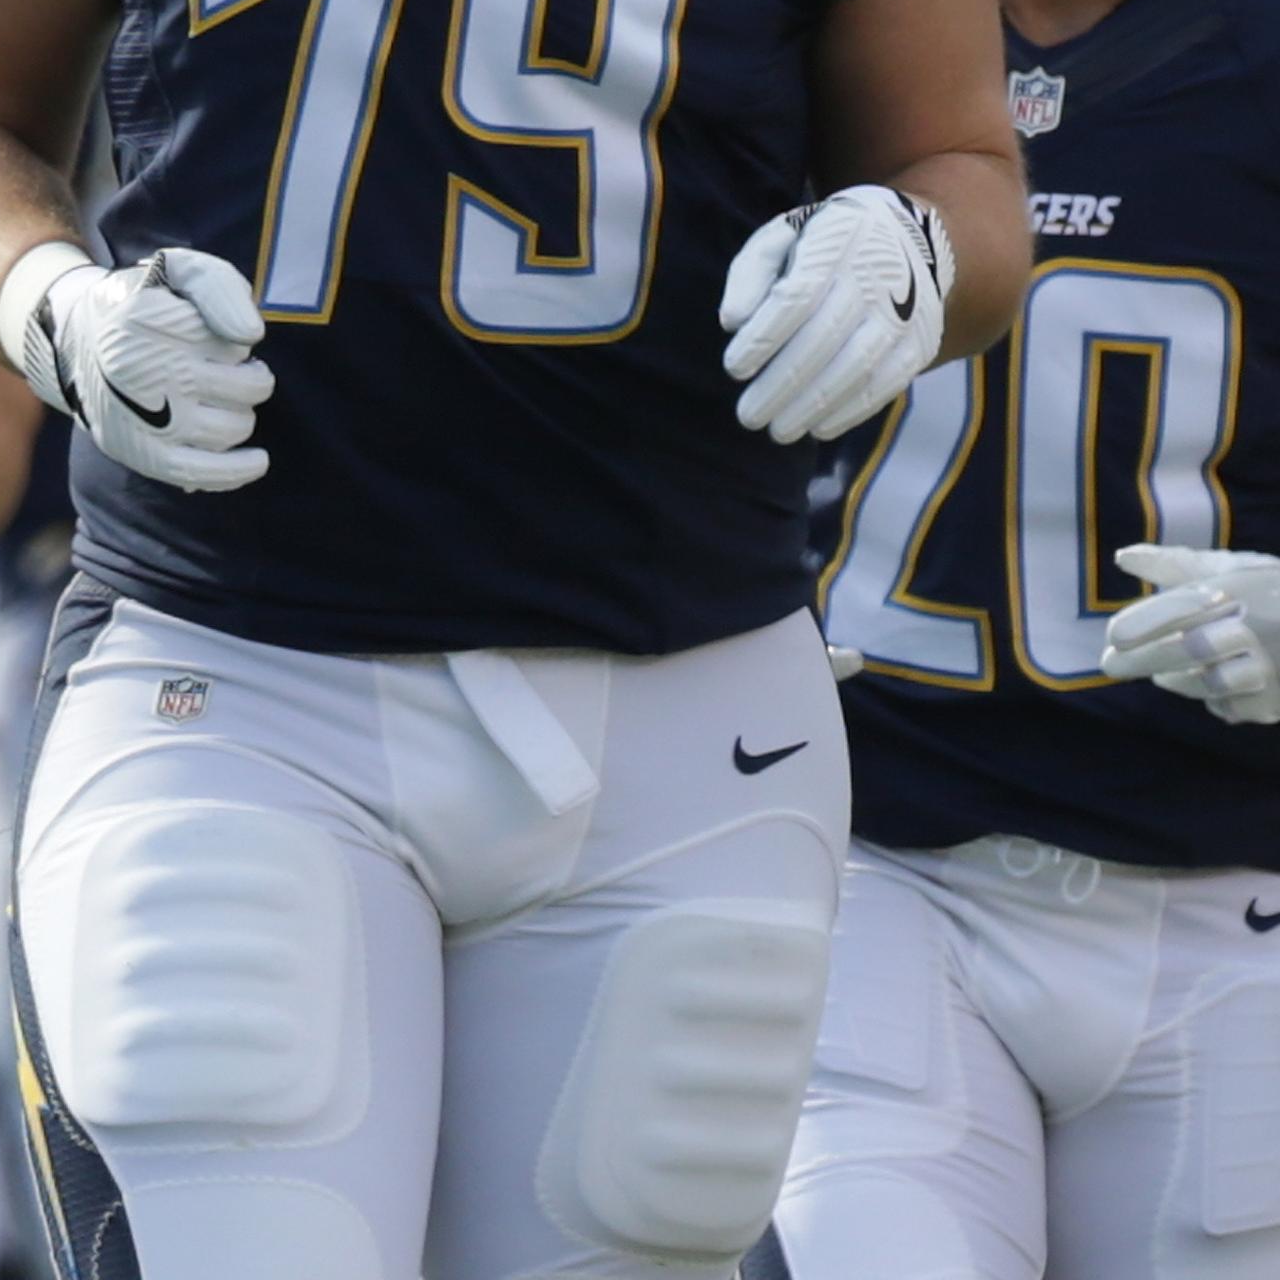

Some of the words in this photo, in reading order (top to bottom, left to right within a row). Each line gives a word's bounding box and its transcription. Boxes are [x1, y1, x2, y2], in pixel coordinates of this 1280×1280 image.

[1013, 97, 1055, 125] NFL
[1027, 193, 1122, 238] GERS
[817, 257, 1243, 693] 20
